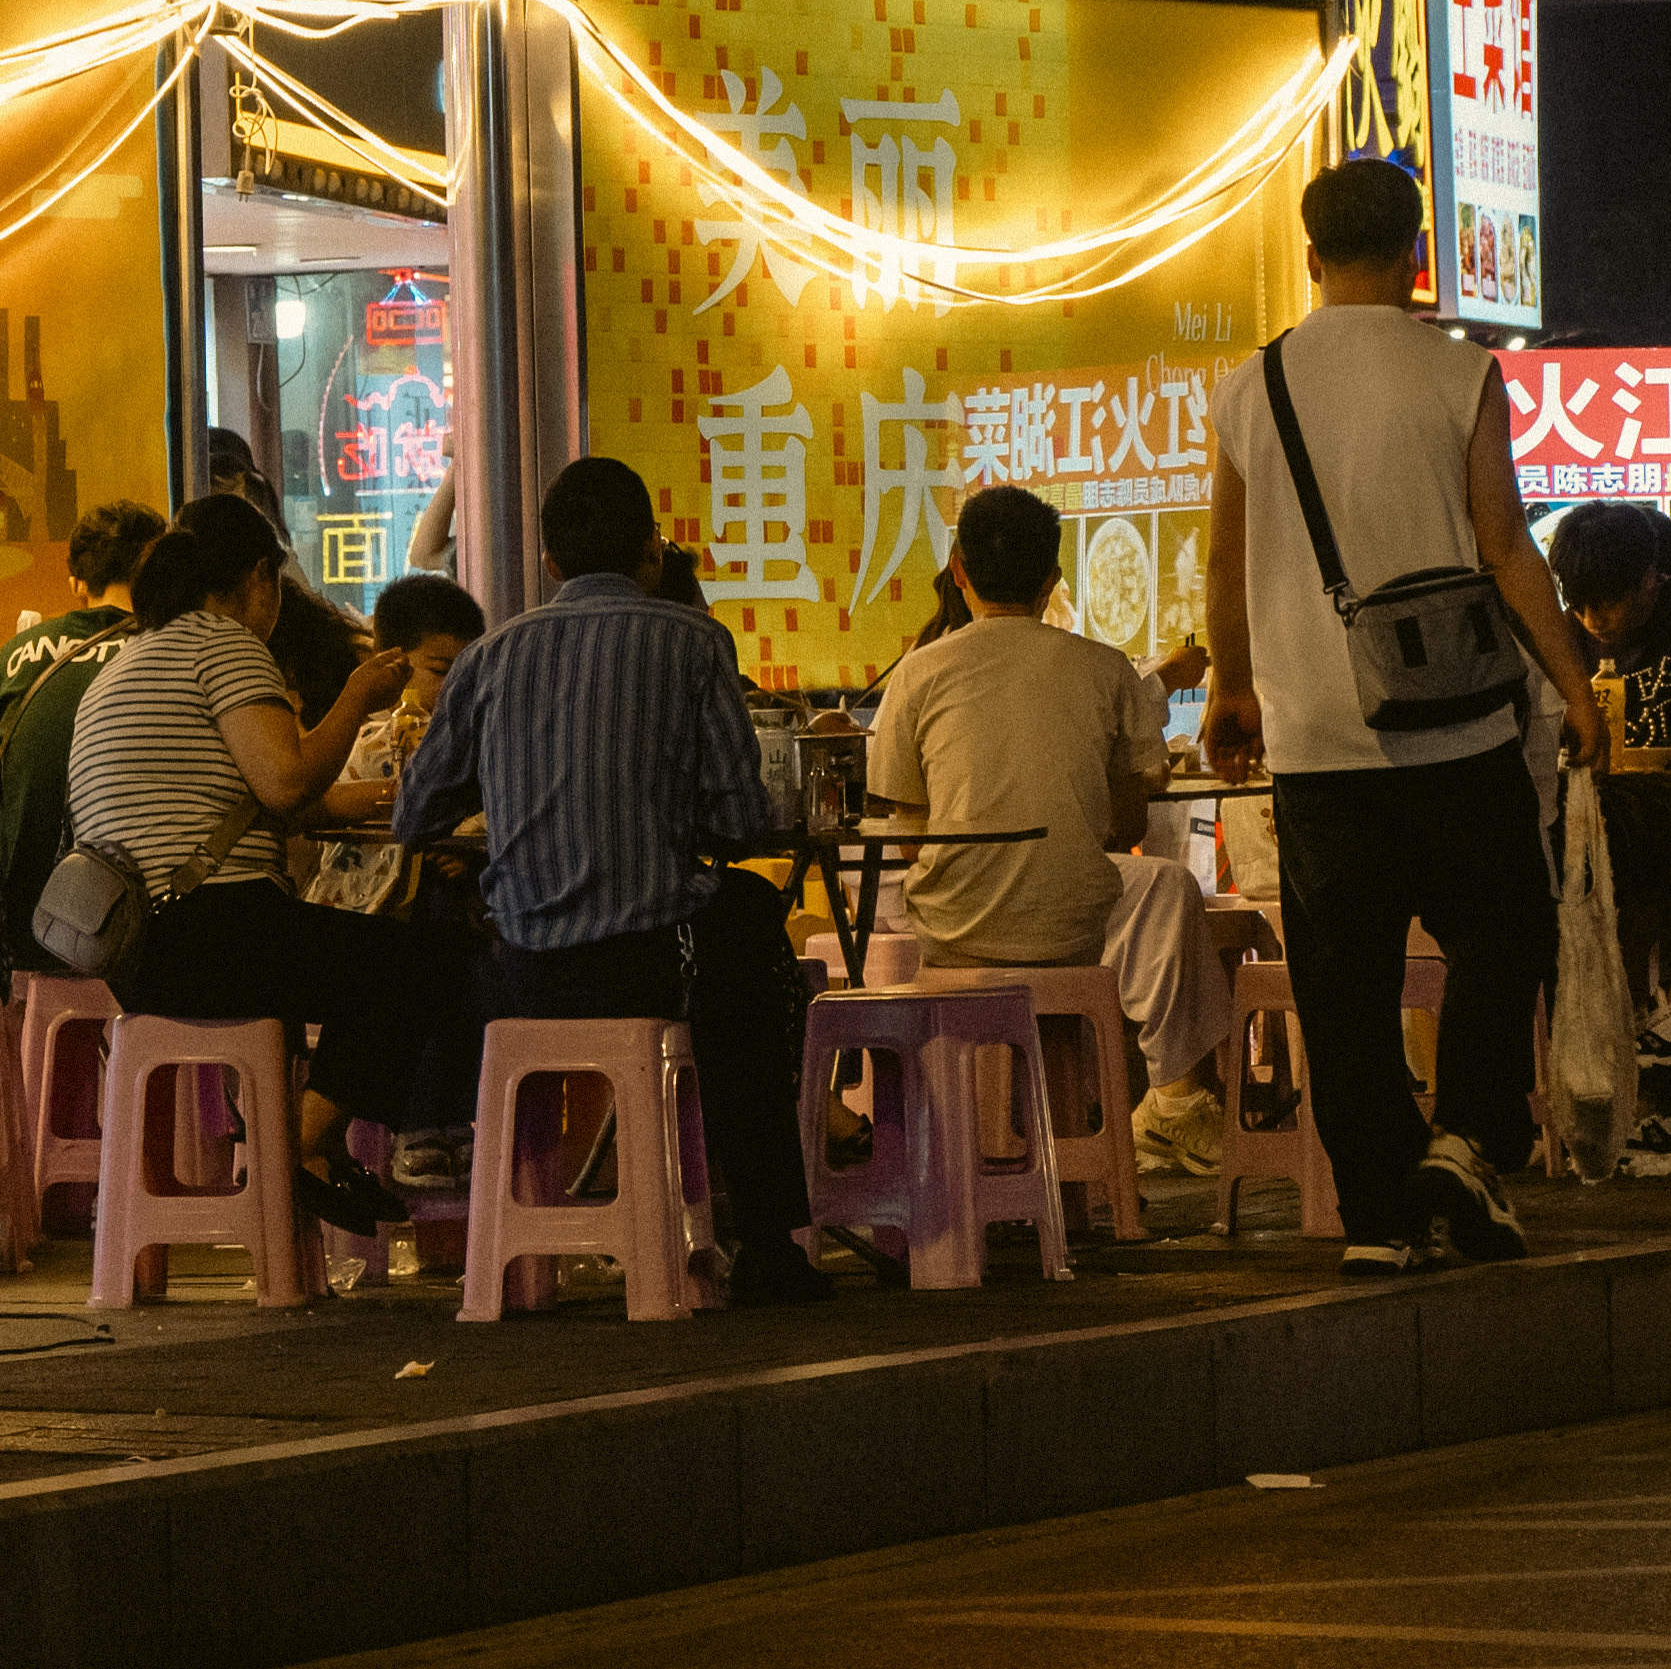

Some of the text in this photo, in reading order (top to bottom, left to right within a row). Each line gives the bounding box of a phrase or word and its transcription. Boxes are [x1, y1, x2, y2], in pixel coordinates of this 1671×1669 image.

[692, 66, 961, 319] 美丽
[1173, 302, 1232, 342] Mei Li
[696, 365, 967, 618] 重庆
[6, 635, 127, 679] CANOT
